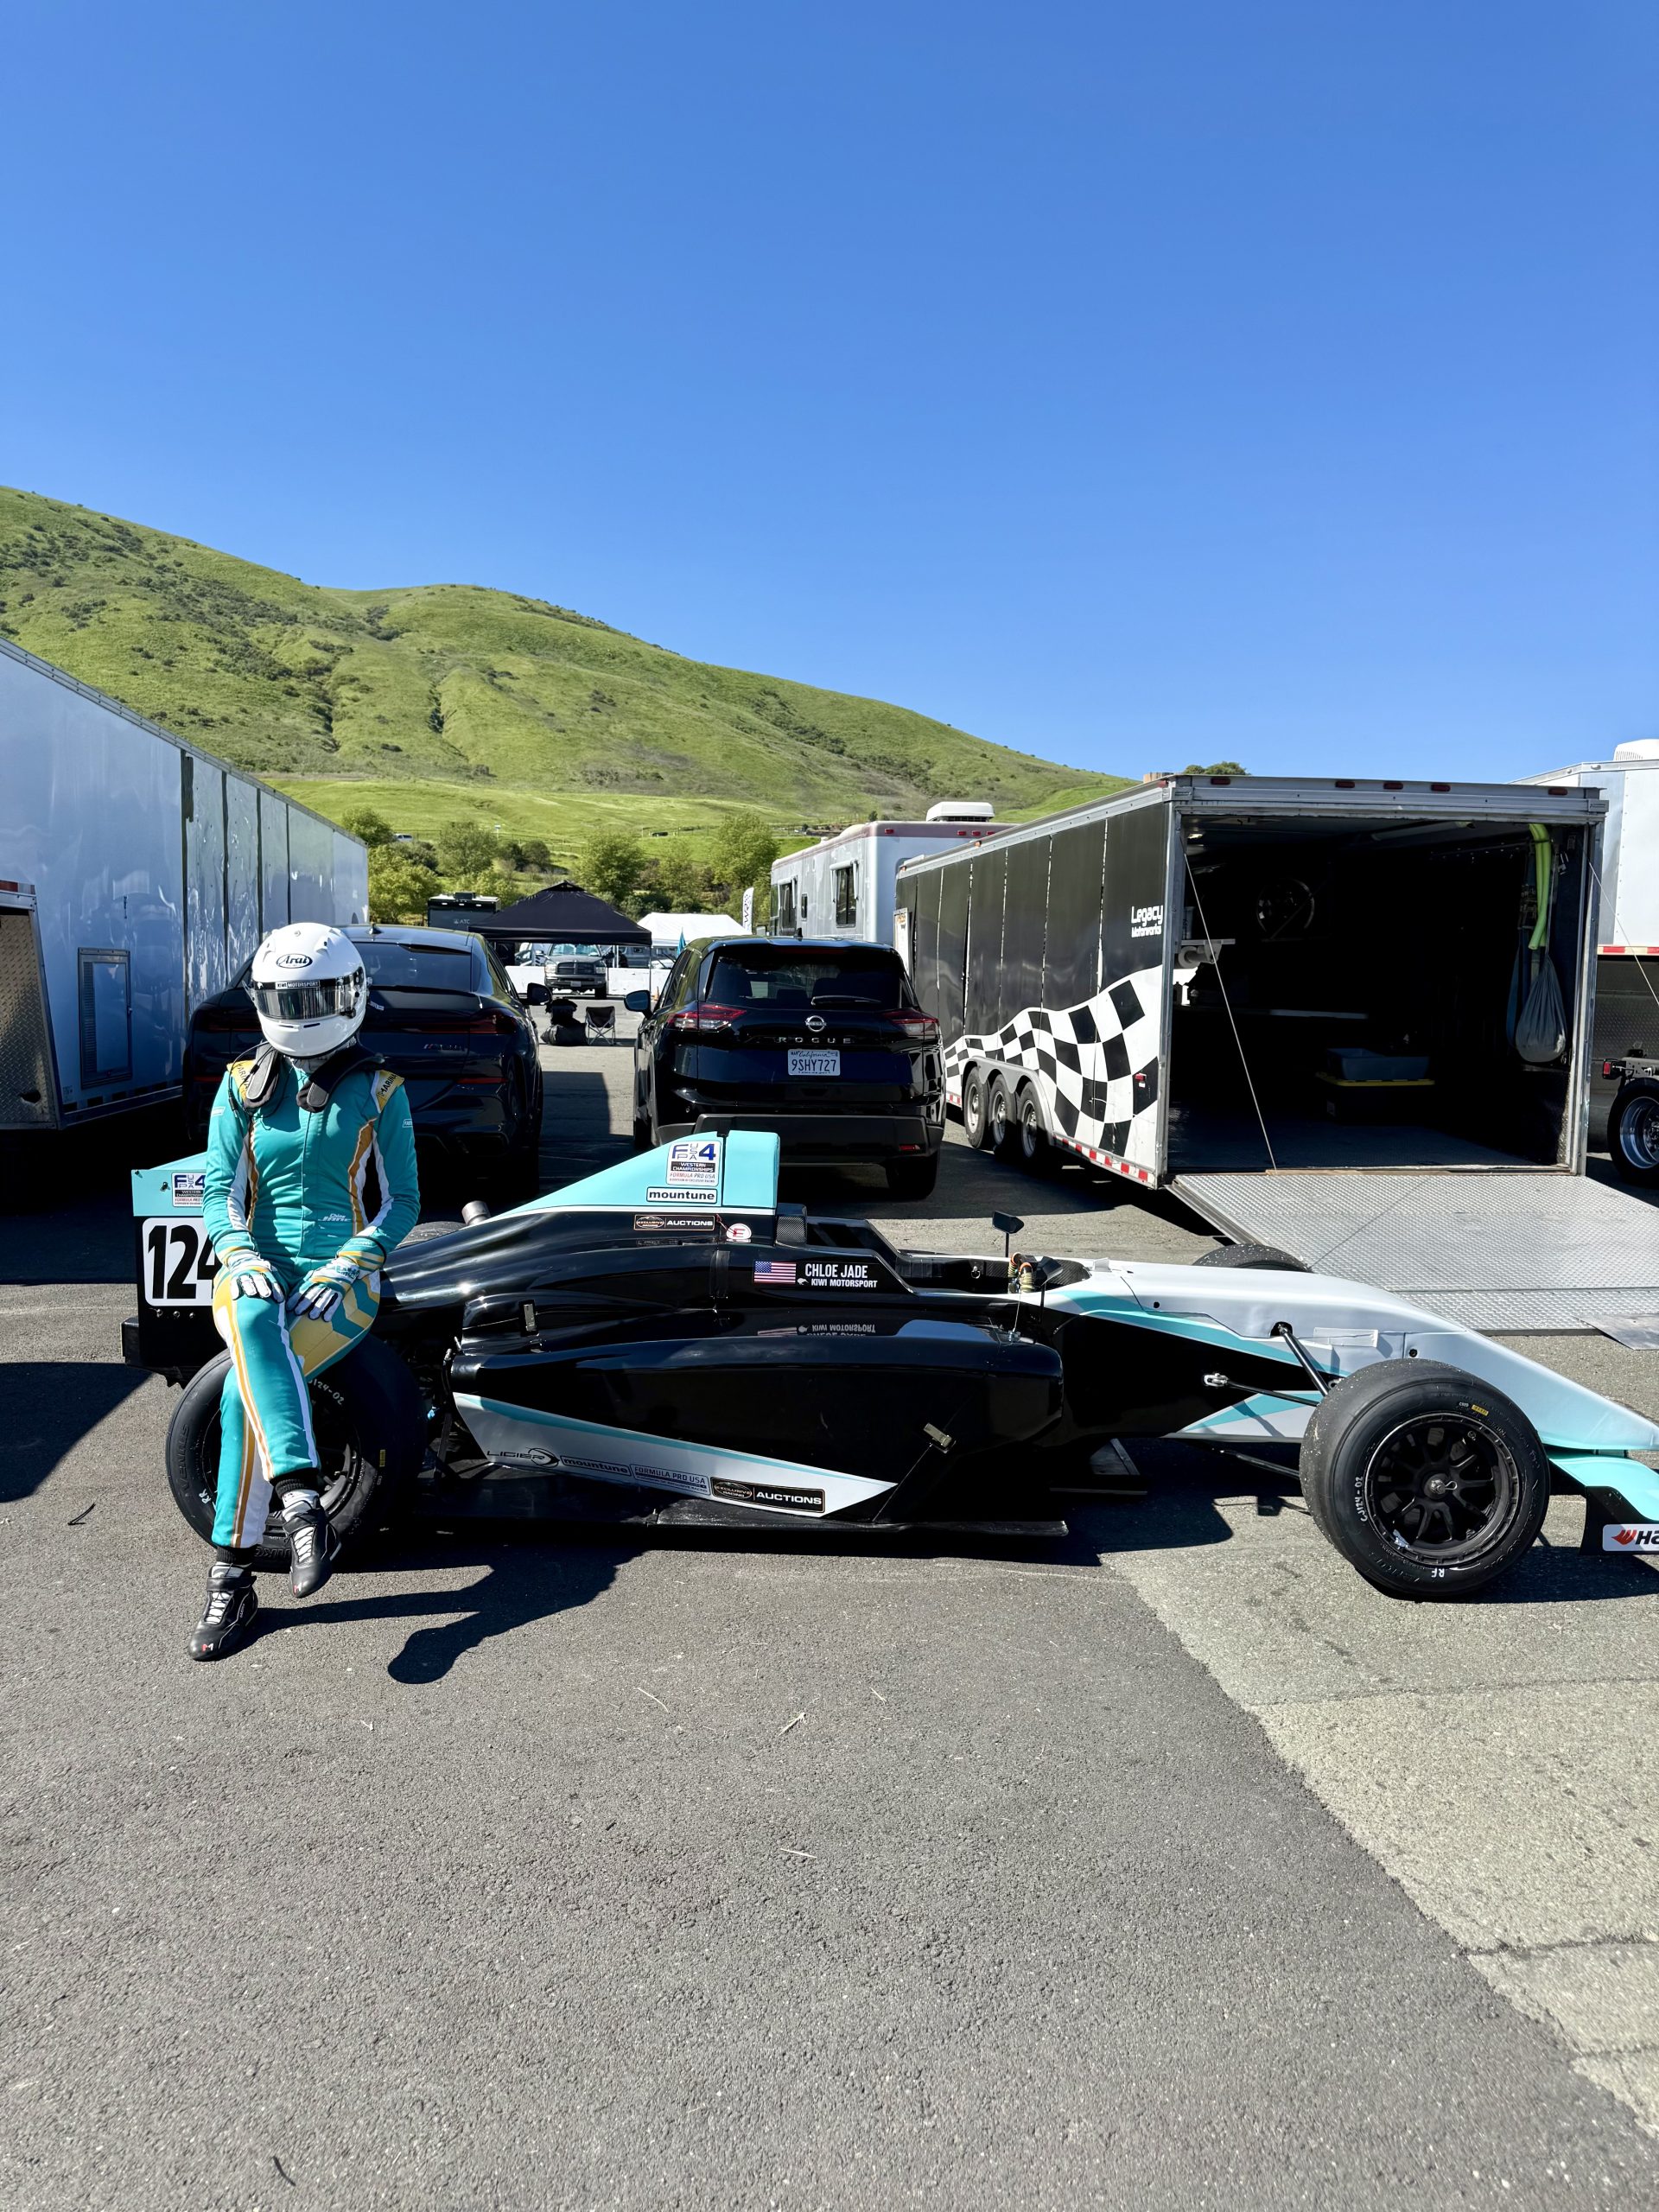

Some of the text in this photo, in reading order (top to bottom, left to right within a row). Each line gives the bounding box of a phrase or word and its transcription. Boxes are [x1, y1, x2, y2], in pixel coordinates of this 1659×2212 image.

[1131, 905, 1163, 927] Legacy
[278, 955, 308, 965] Arai
[791, 1059, 836, 1072] 9SHY727
[649, 1191, 715, 1200] mountune
[148, 1224, 222, 1300] 124
[804, 1263, 868, 1278] CHLOE JADE
[810, 1278, 878, 1287] KIWI MOTORSPORT
[308, 1378, 345, 1406] 124-02
[486, 1451, 546, 1460] LIGIER
[563, 1458, 629, 1473] mountune
[635, 1466, 671, 1478] FORMULA
[672, 1472, 688, 1481] PRO
[690, 1476, 706, 1484] USA
[756, 1491, 823, 1504] AUCTIONS
[1431, 1567, 1445, 1578] RF
